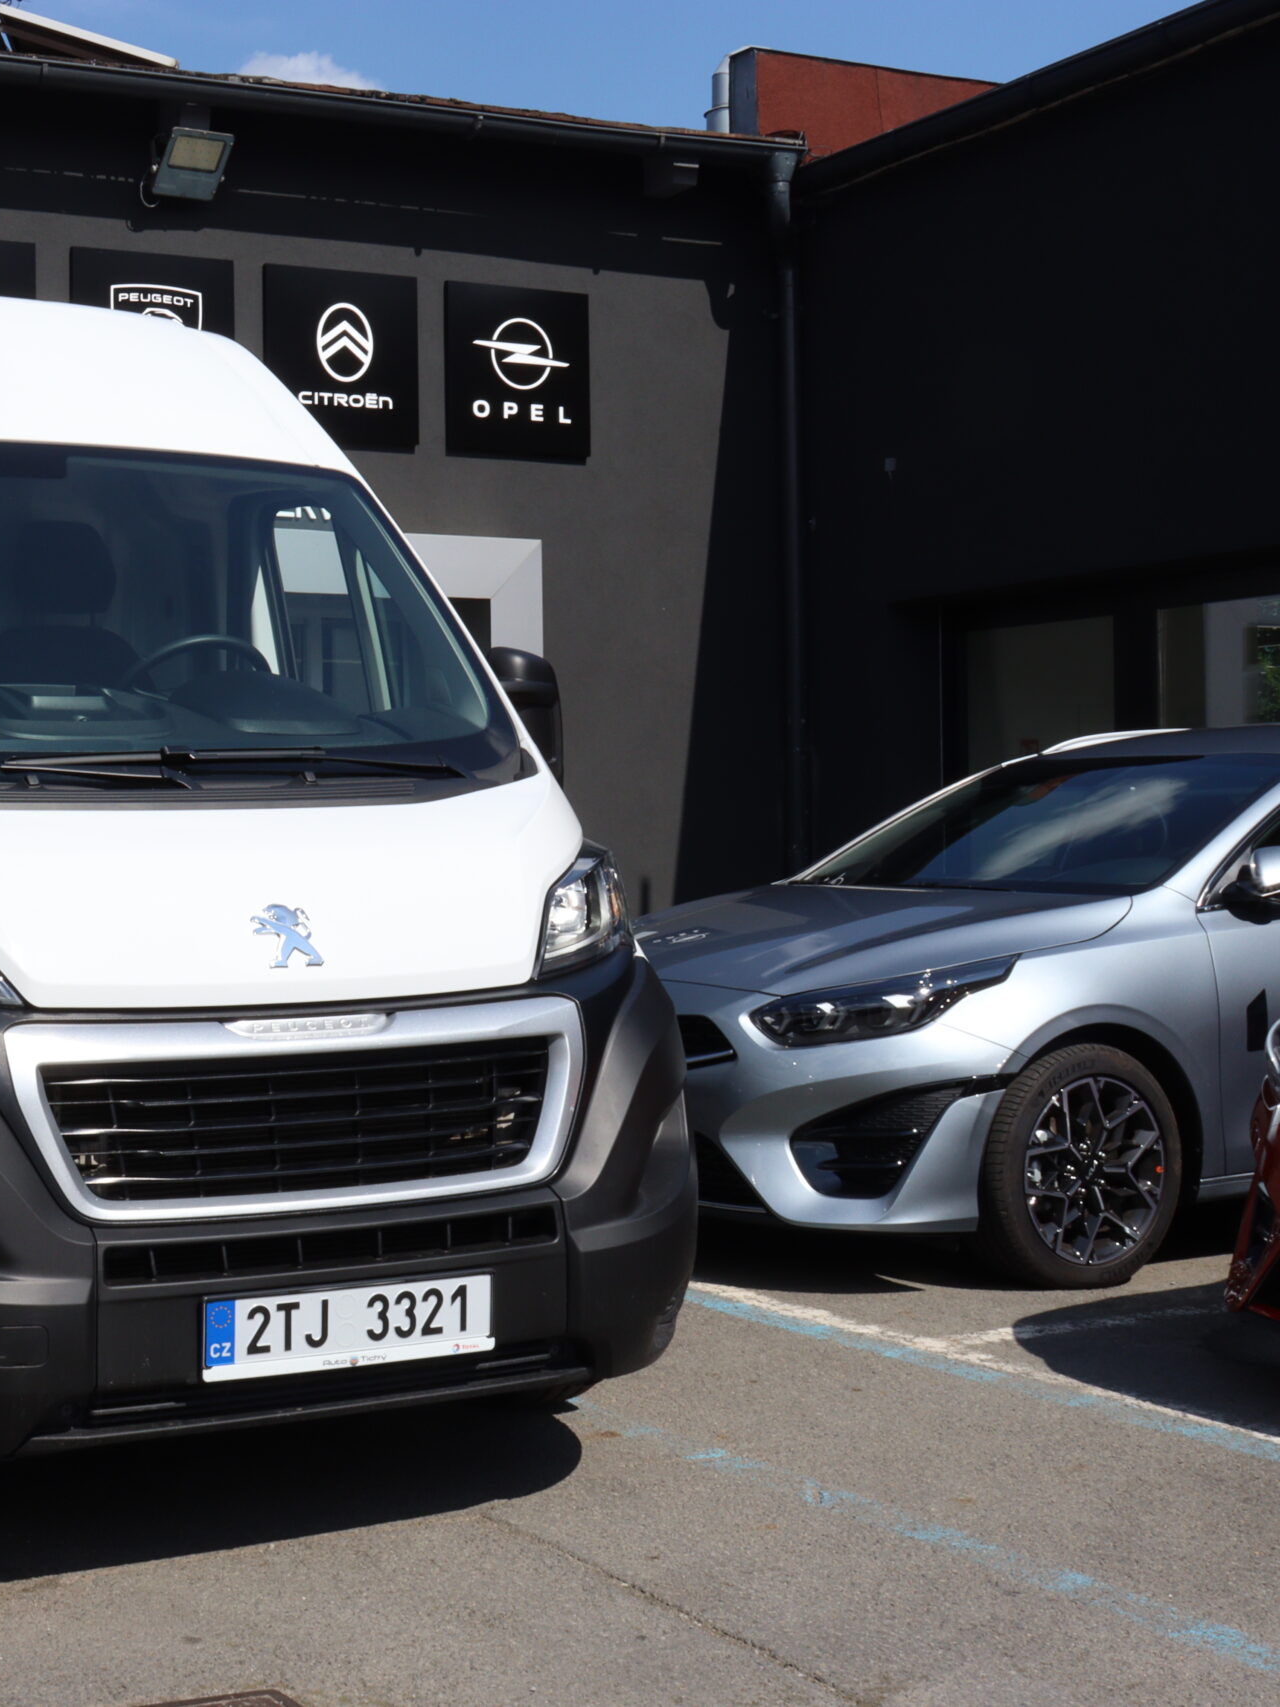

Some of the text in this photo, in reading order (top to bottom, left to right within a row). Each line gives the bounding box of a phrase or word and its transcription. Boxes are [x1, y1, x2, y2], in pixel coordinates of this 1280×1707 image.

[118, 293, 194, 308] PEUGEOT
[472, 399, 572, 424] OPEL
[246, 1284, 468, 1355] 2TJ 3321
[209, 1342, 232, 1358] CZ
